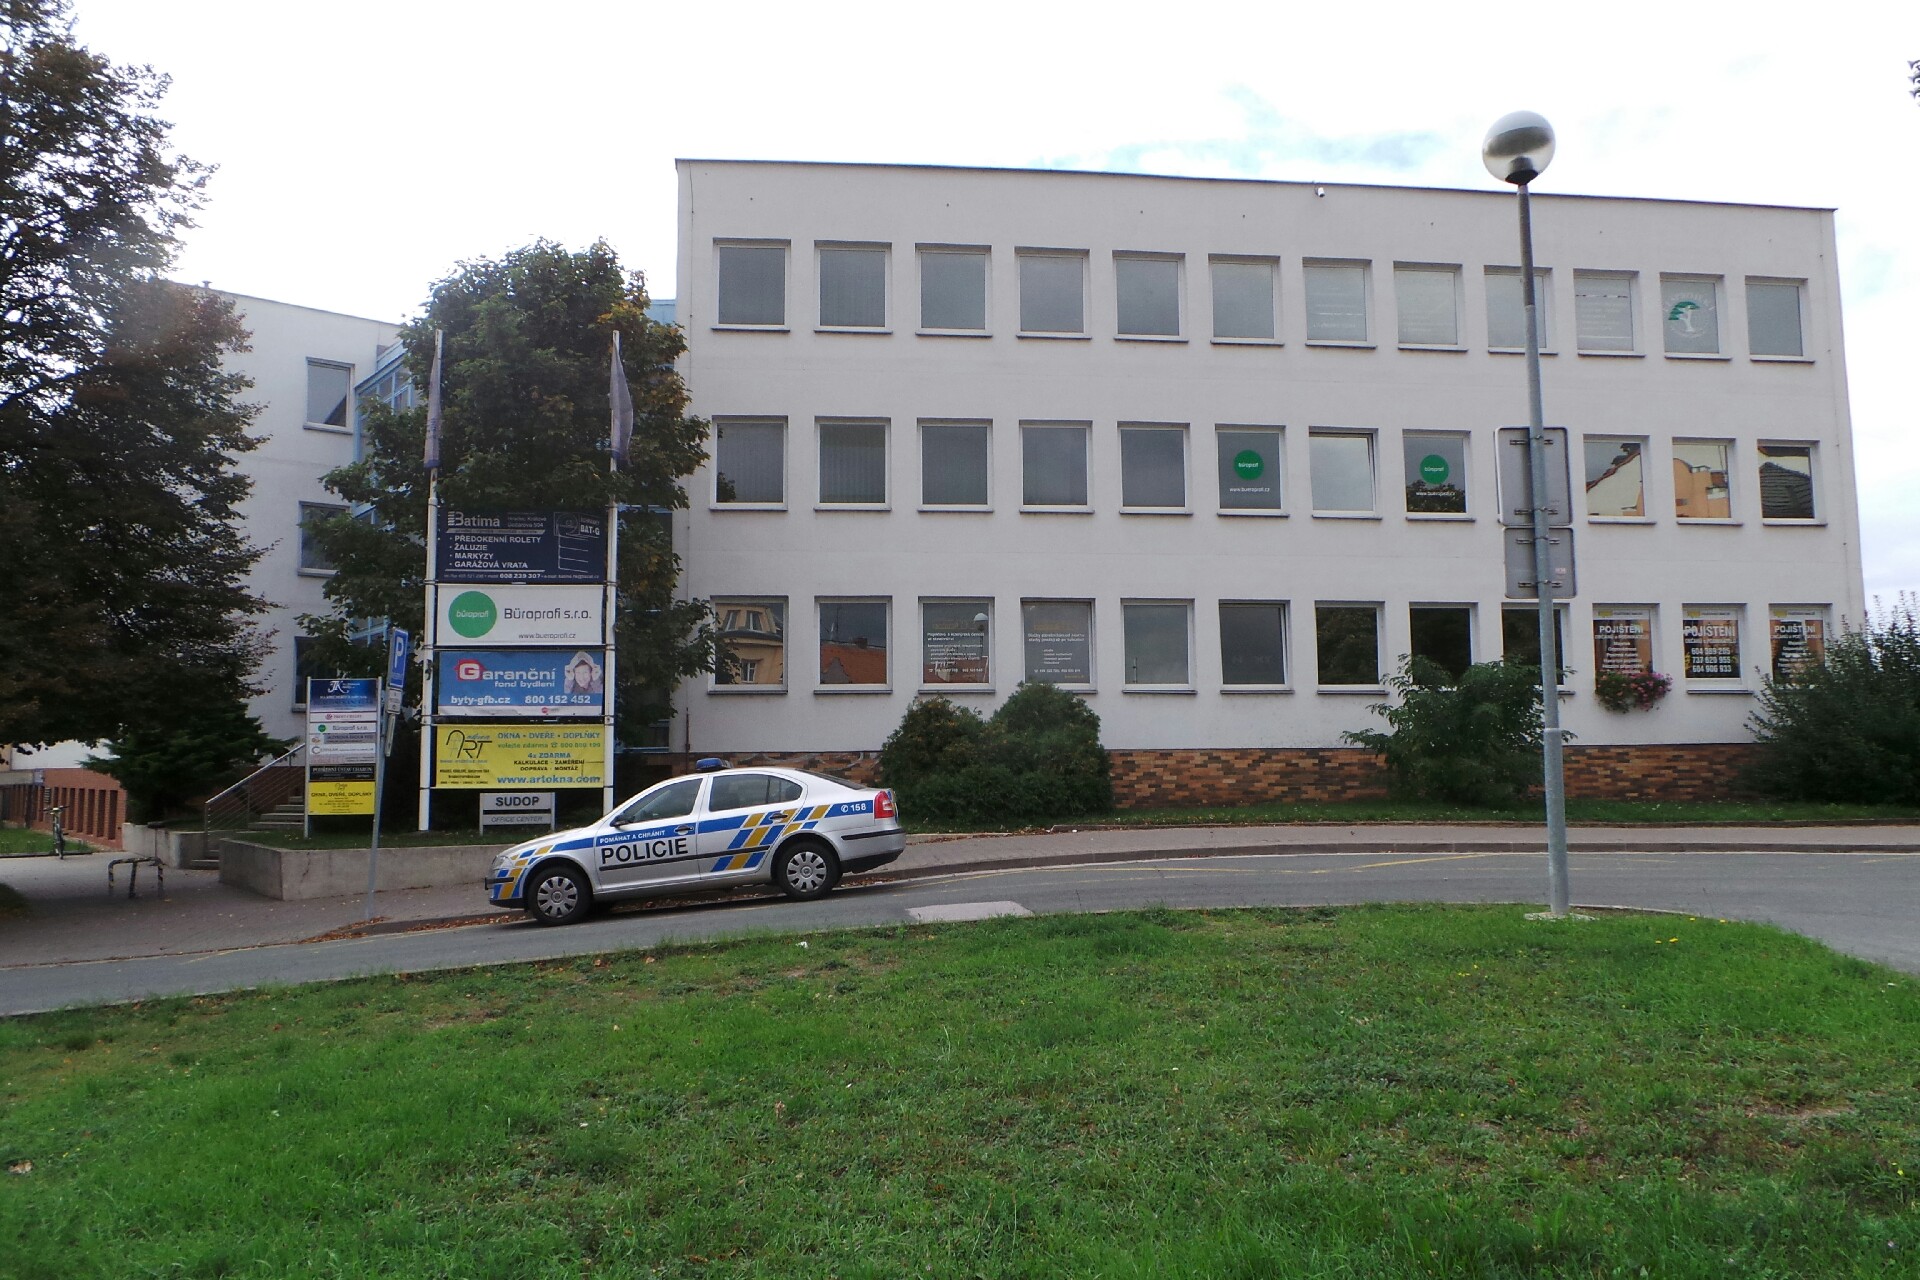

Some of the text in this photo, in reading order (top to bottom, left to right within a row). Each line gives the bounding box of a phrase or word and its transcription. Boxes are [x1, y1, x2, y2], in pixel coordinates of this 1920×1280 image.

[448, 511, 500, 527] Batima
[454, 534, 507, 543] PŘEDOKENNÍ
[454, 542, 488, 551] ŽALUZIE
[454, 552, 494, 560] MARKÝZY
[454, 560, 529, 569] GARÁŽOVÁ VRATA
[504, 607, 592, 622] Büroprofi s.r.o.
[459, 663, 557, 681] Garanční
[494, 680, 555, 689] fond bydlení
[451, 694, 591, 706] byty-gfb.cz 800 152 452
[528, 731, 555, 739] DVEŘE
[563, 731, 600, 739] DOPLŇKY
[497, 774, 601, 784] www.artokna.com
[495, 796, 540, 807] SUDOP
[850, 803, 867, 812] 158
[516, 815, 543, 823] CENTER
[600, 835, 631, 844] POMÁHAT
[638, 830, 666, 839] CHRÁNIT
[601, 837, 689, 865] POLICIE
